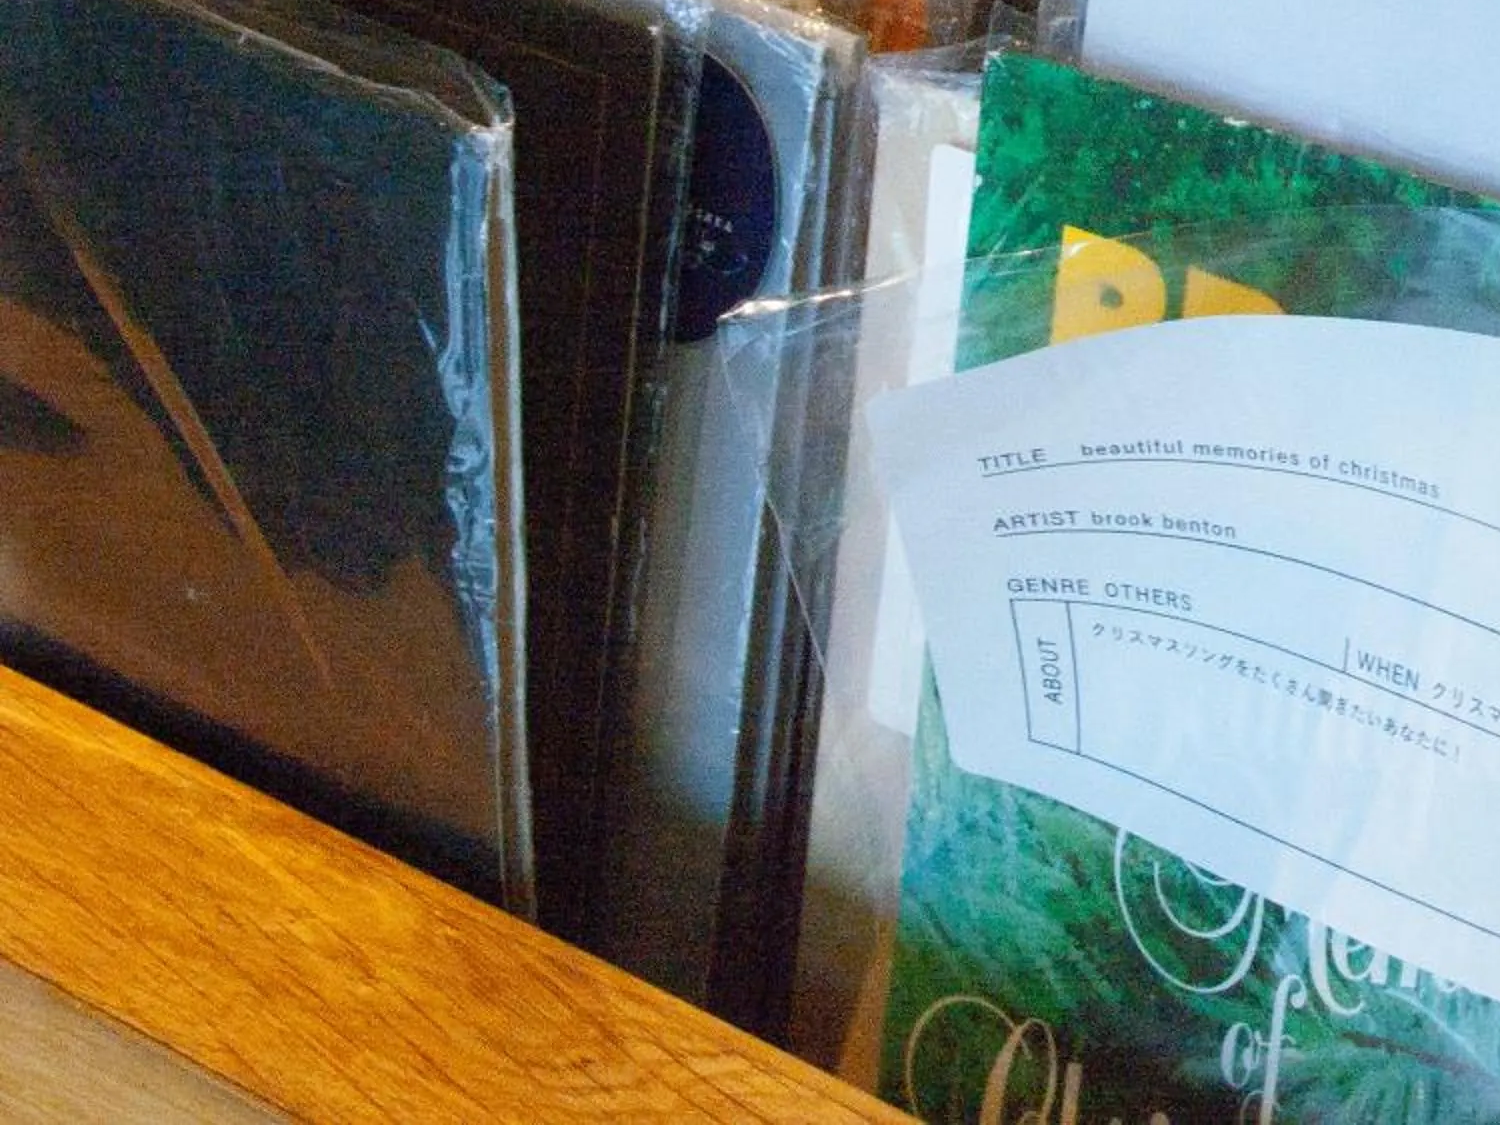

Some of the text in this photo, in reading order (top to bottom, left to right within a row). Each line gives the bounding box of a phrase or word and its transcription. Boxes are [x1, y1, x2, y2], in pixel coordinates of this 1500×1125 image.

[977, 439, 1441, 500] TITLE beautiful memories of christmas
[993, 510, 1237, 540] ARTIST brook benton
[1006, 577, 1194, 613] GENRE OTHERS
[1037, 636, 1061, 706] ABOUT
[1356, 648, 1421, 692] WHEN
